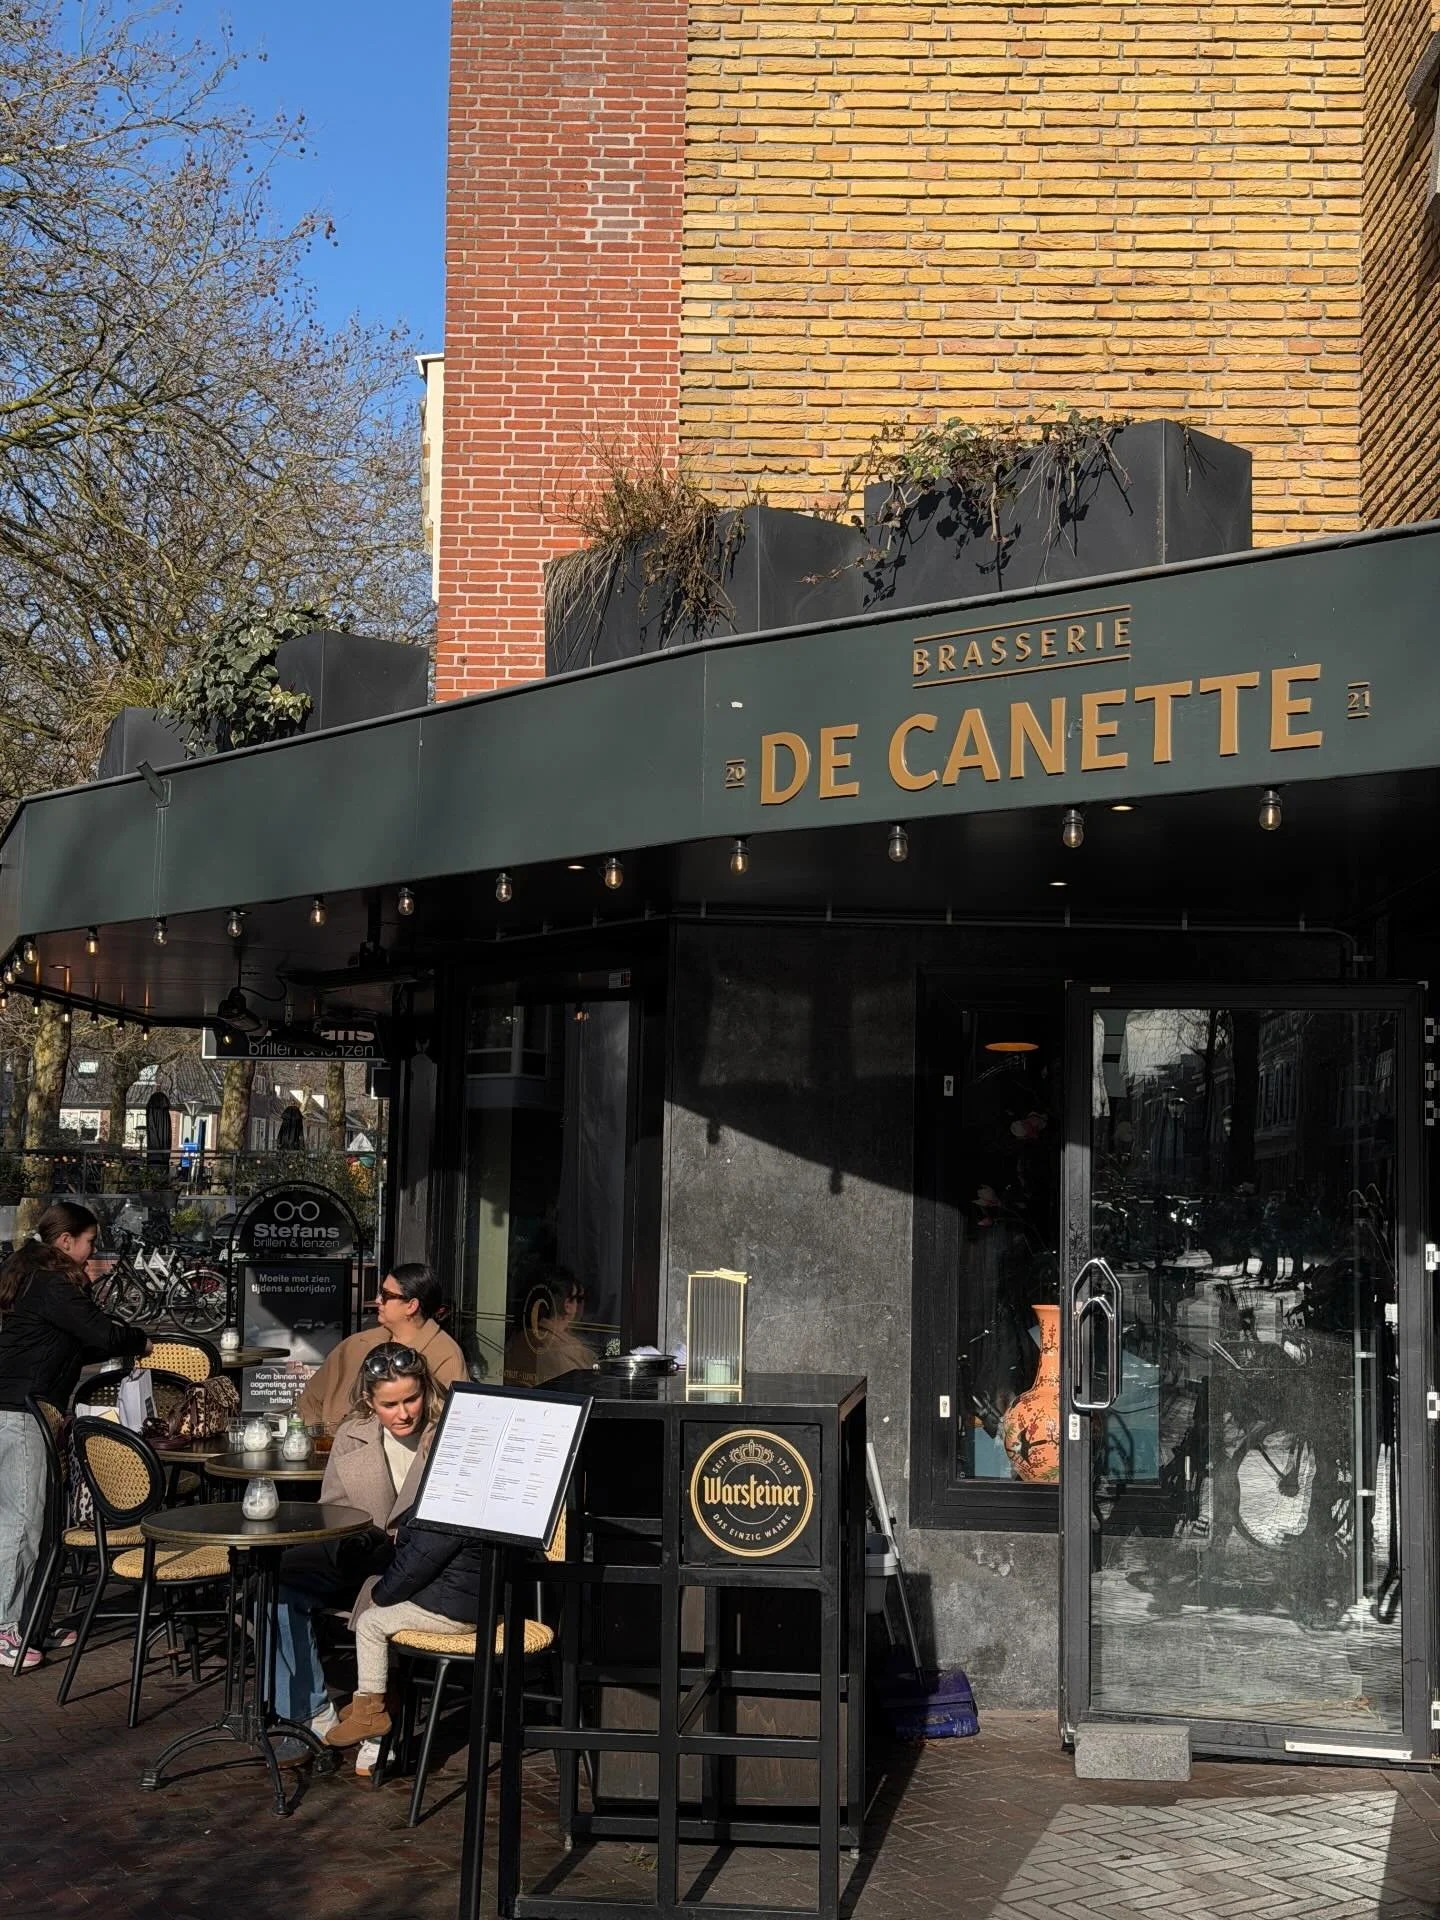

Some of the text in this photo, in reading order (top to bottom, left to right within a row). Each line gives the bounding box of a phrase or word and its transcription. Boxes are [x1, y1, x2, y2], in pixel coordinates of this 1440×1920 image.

[912, 617, 1132, 676] BRASSERIE
[725, 663, 1372, 806] 20 DE CANETTE 21
[254, 1224, 340, 1238] Stefans
[253, 1238, 340, 1248] brillen & lenzen
[259, 1274, 330, 1283] Moeite met zien
[251, 1283, 337, 1295] tijdens autorijden?
[712, 1455, 728, 1474] SEIT
[777, 1457, 792, 1475] 1753
[703, 1474, 802, 1510] Warsteiner
[712, 1513, 792, 1541] DAS EINZIG WAHRE
